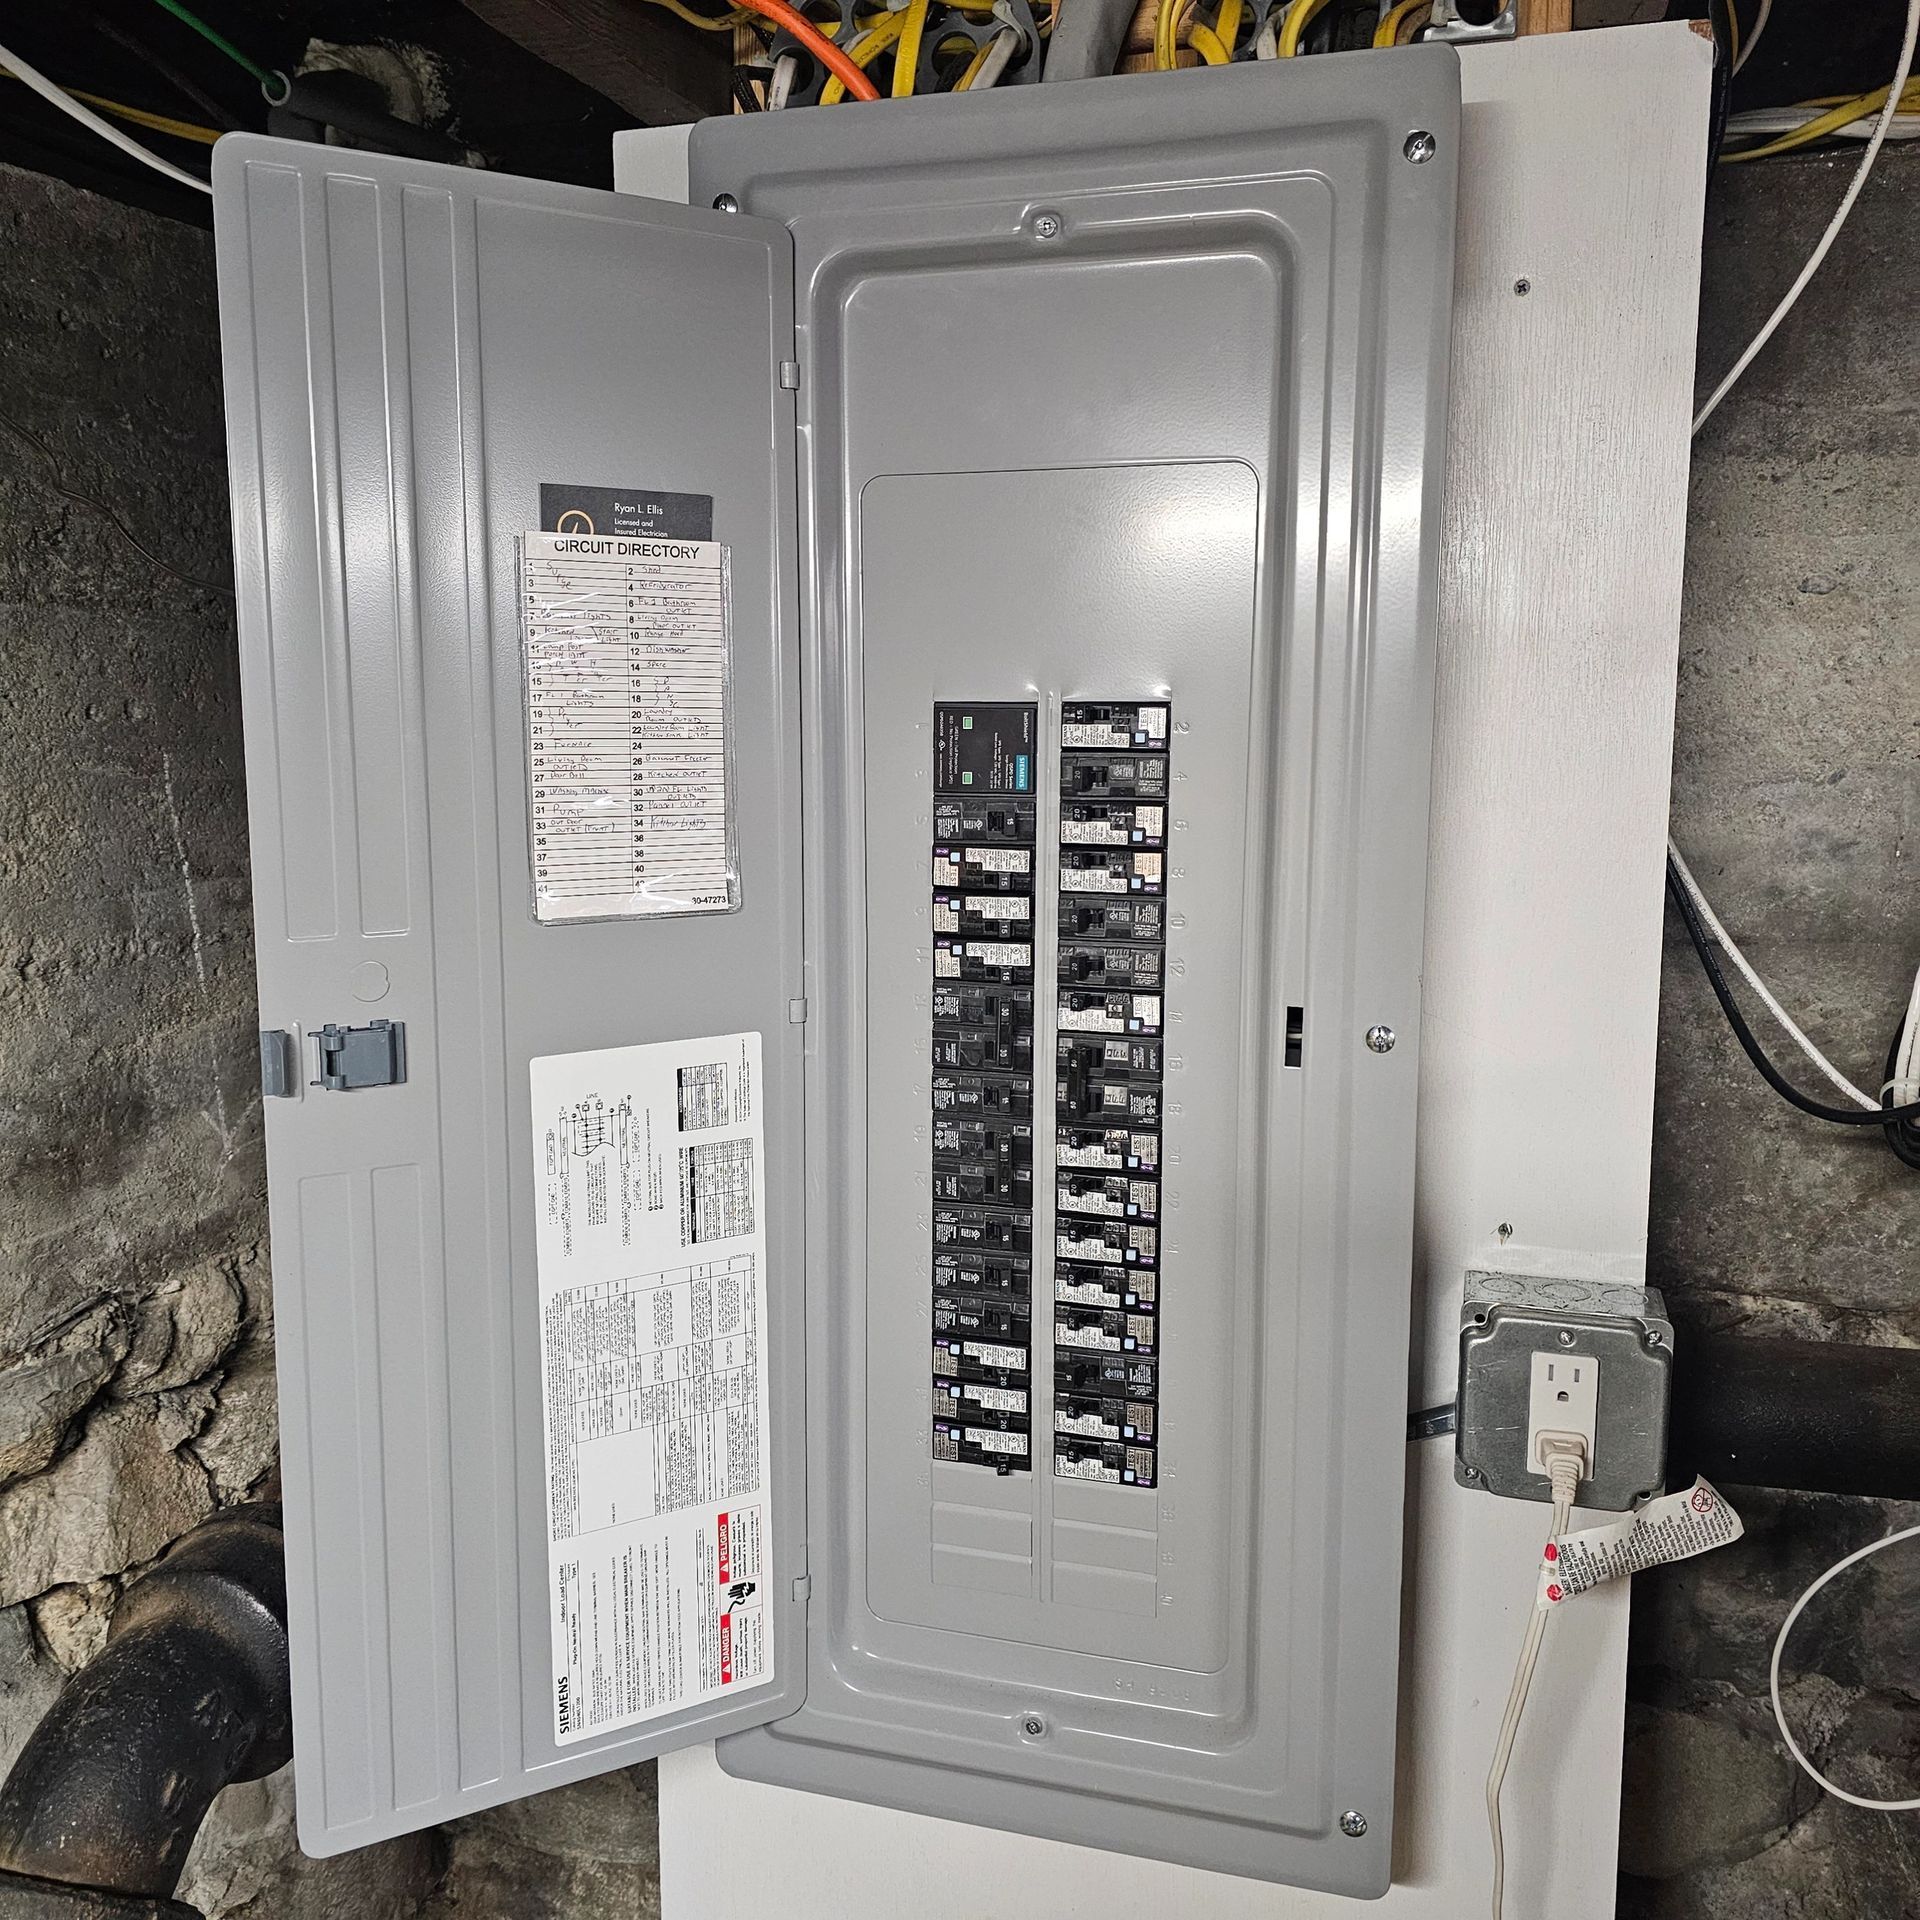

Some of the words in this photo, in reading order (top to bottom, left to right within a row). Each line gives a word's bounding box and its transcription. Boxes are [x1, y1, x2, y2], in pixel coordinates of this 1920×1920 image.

[614, 503, 635, 515] Ryan
[638, 505, 644, 513] L.
[647, 505, 663, 515] Ellis
[614, 518, 640, 527] Licensed
[614, 528, 636, 536] Insured
[637, 529, 668, 538] Electrician
[554, 539, 614, 554] CIRCUIT
[617, 542, 699, 559] DIRECTORY
[528, 579, 534, 587] 3
[529, 596, 535, 604] 5
[629, 616, 634, 624] 8
[630, 632, 639, 640] 10
[532, 694, 542, 702] 17
[632, 695, 641, 703] 18
[1077, 709, 1083, 719] 15
[533, 726, 543, 734] 21
[632, 726, 641, 734] 22
[533, 742, 544, 750] 23
[632, 742, 642, 750] 24
[632, 758, 642, 766] 26
[534, 774, 544, 782] 27
[1075, 770, 1080, 779] 20
[535, 790, 545, 798] 29
[535, 806, 545, 814] 31
[633, 804, 643, 812] 32
[1074, 808, 1080, 818] 20
[535, 822, 546, 830] 33
[536, 838, 547, 846] 35
[536, 853, 547, 861] 37
[1073, 856, 1079, 866] 20
[537, 869, 548, 877] 39
[1001, 877, 1008, 886] 15
[692, 896, 726, 905] 30-47273
[1072, 914, 1078, 923] 20
[1001, 924, 1008, 934] 15
[1072, 962, 1078, 971] 20
[1002, 972, 1010, 981] 15
[1072, 998, 1078, 1008] 20
[1001, 1007, 1009, 1016] 30
[999, 1049, 1007, 1057] 30
[1071, 1136, 1078, 1146] 20
[1000, 1144, 1009, 1152] 30
[1001, 1184, 1008, 1192] 30
[1071, 1184, 1077, 1194] 20
[1070, 1230, 1076, 1239] 15
[1068, 1274, 1075, 1285] 20
[1068, 1318, 1075, 1327] 20
[1000, 1377, 1006, 1386] 20
[1068, 1406, 1074, 1416] 20
[1000, 1420, 1006, 1430] 20
[1068, 1450, 1074, 1460] 15
[1000, 1463, 1006, 1472] 15
[719, 1524, 728, 1562] PELIGRO
[722, 1627, 730, 1662] DANGER
[558, 1676, 569, 1734] SIEMENS
